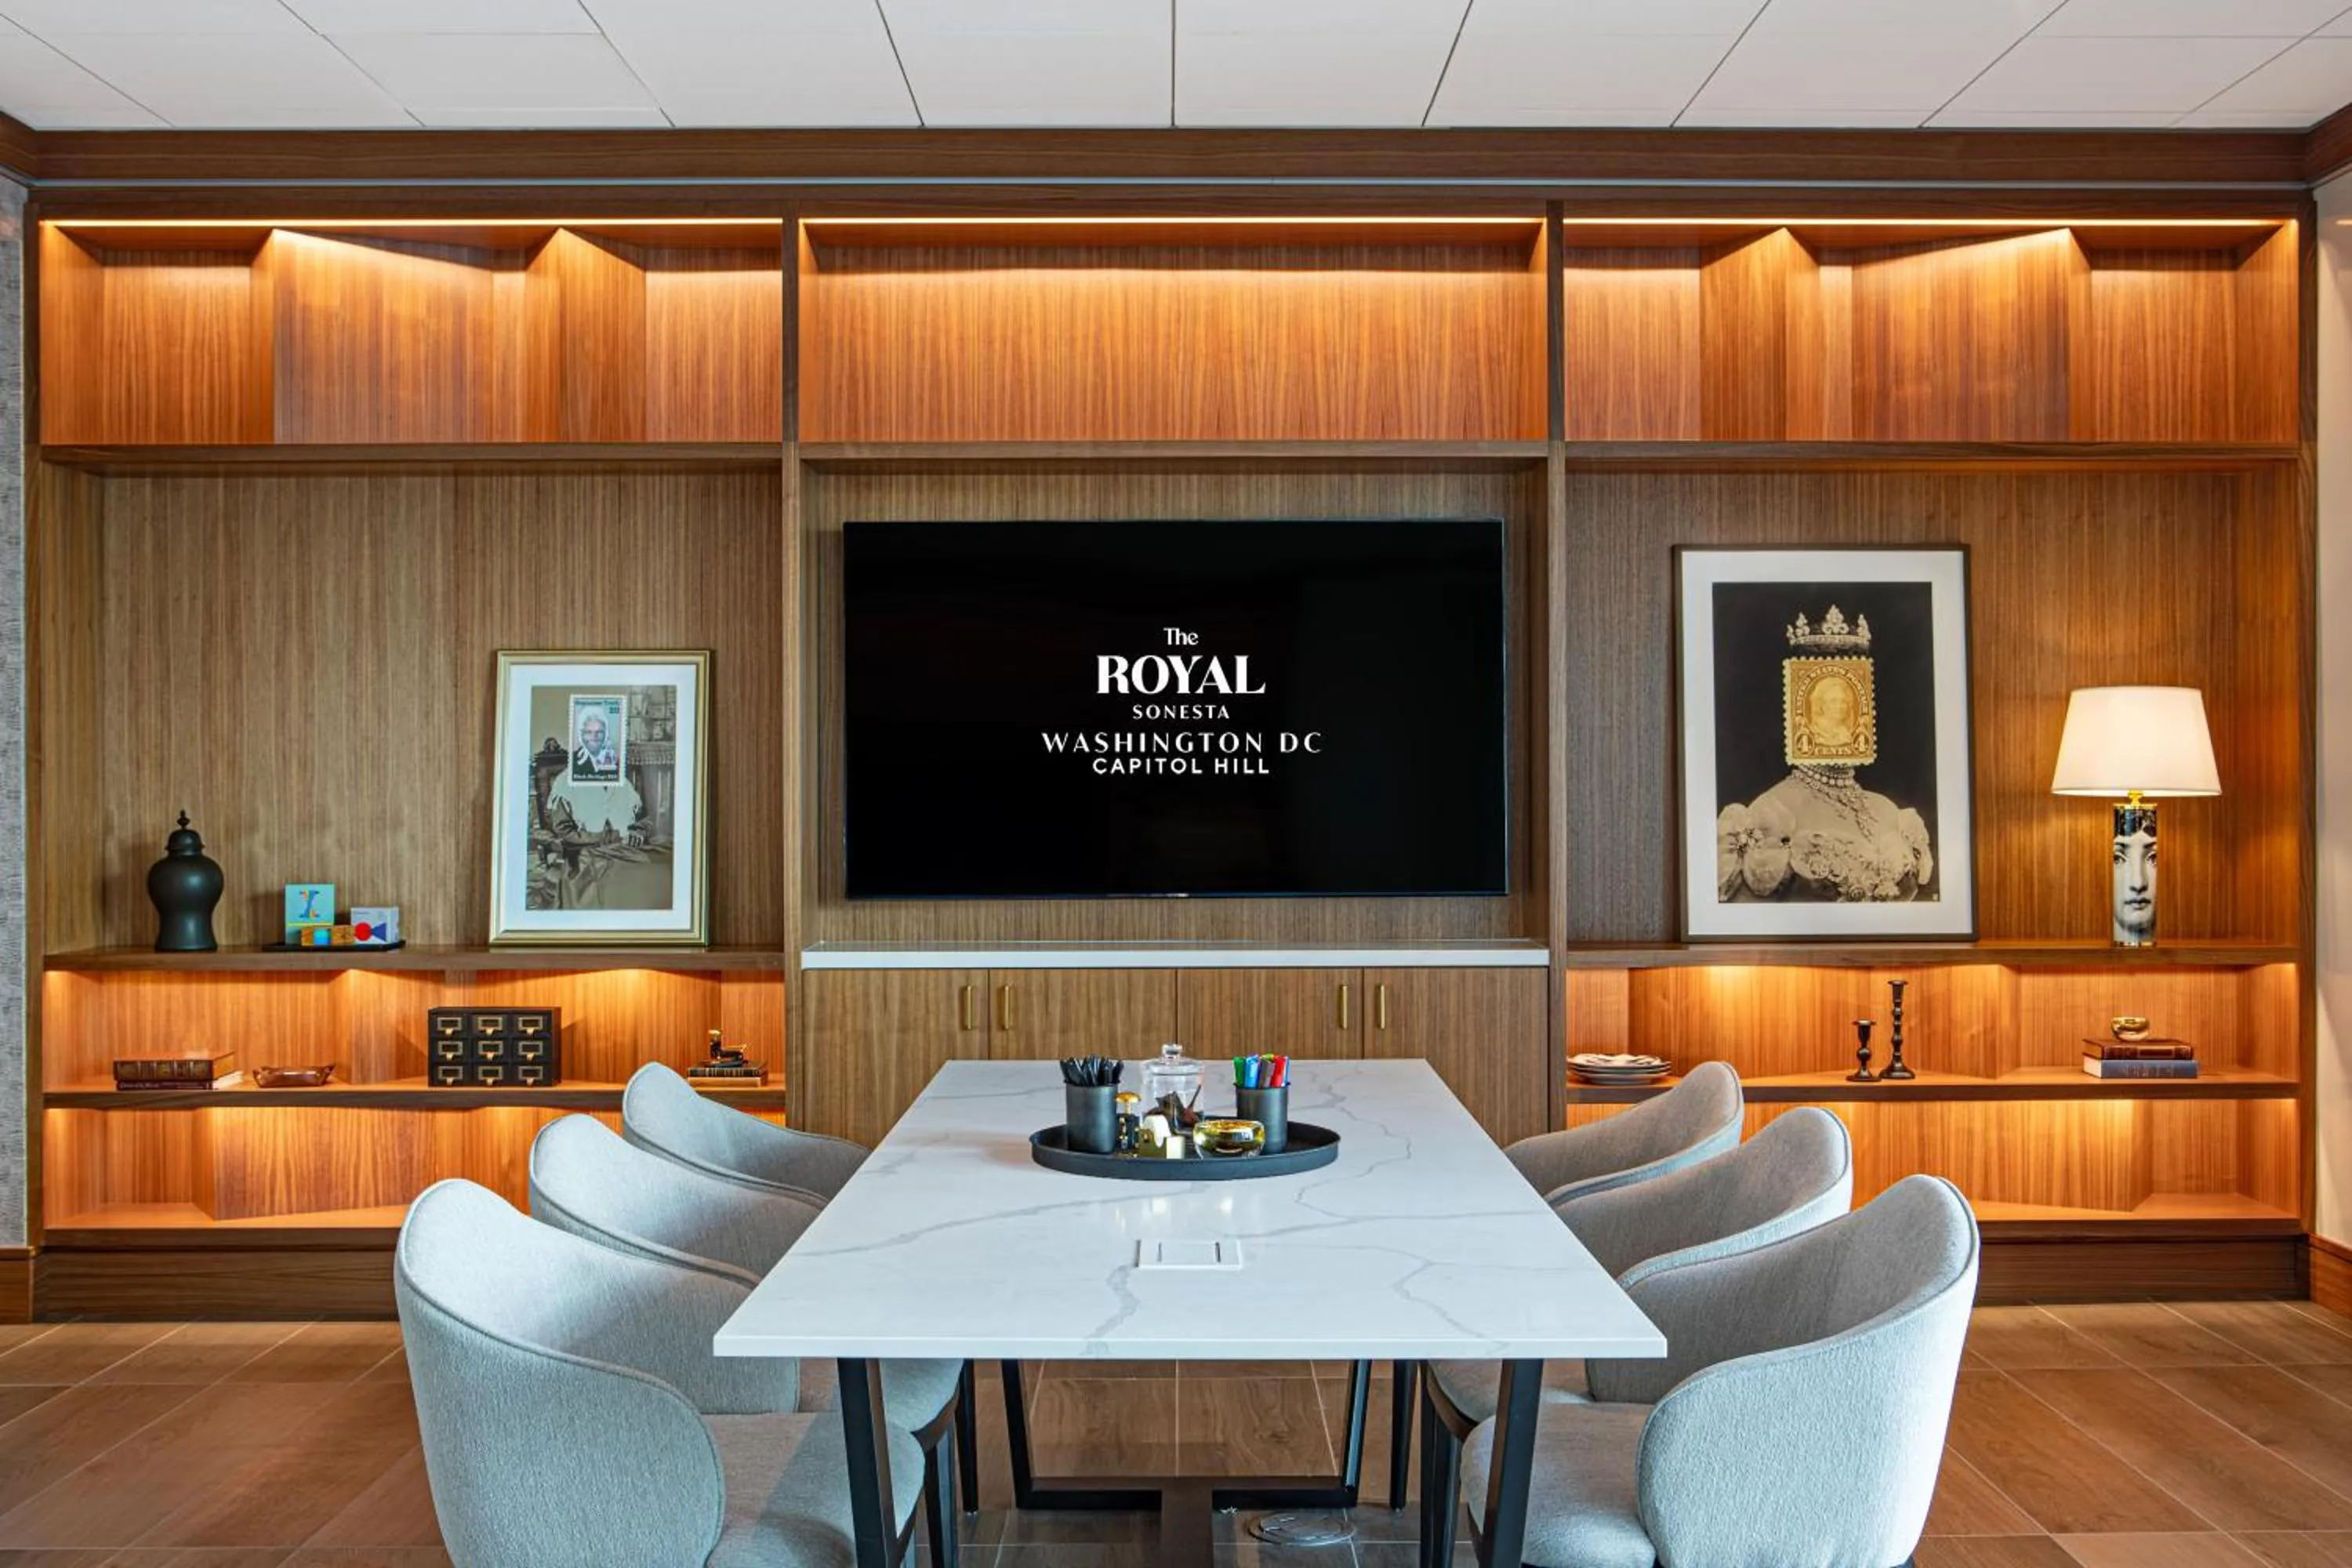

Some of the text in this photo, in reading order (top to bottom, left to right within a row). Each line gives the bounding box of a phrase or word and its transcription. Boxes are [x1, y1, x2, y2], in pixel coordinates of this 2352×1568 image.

[1163, 627, 1199, 645] The
[1097, 655, 1266, 695] ROYAL
[1132, 704, 1230, 720] SONESTA
[1041, 731, 1321, 753] WASHINGTON DC
[1092, 757, 1269, 775] CAPITOL HILL
